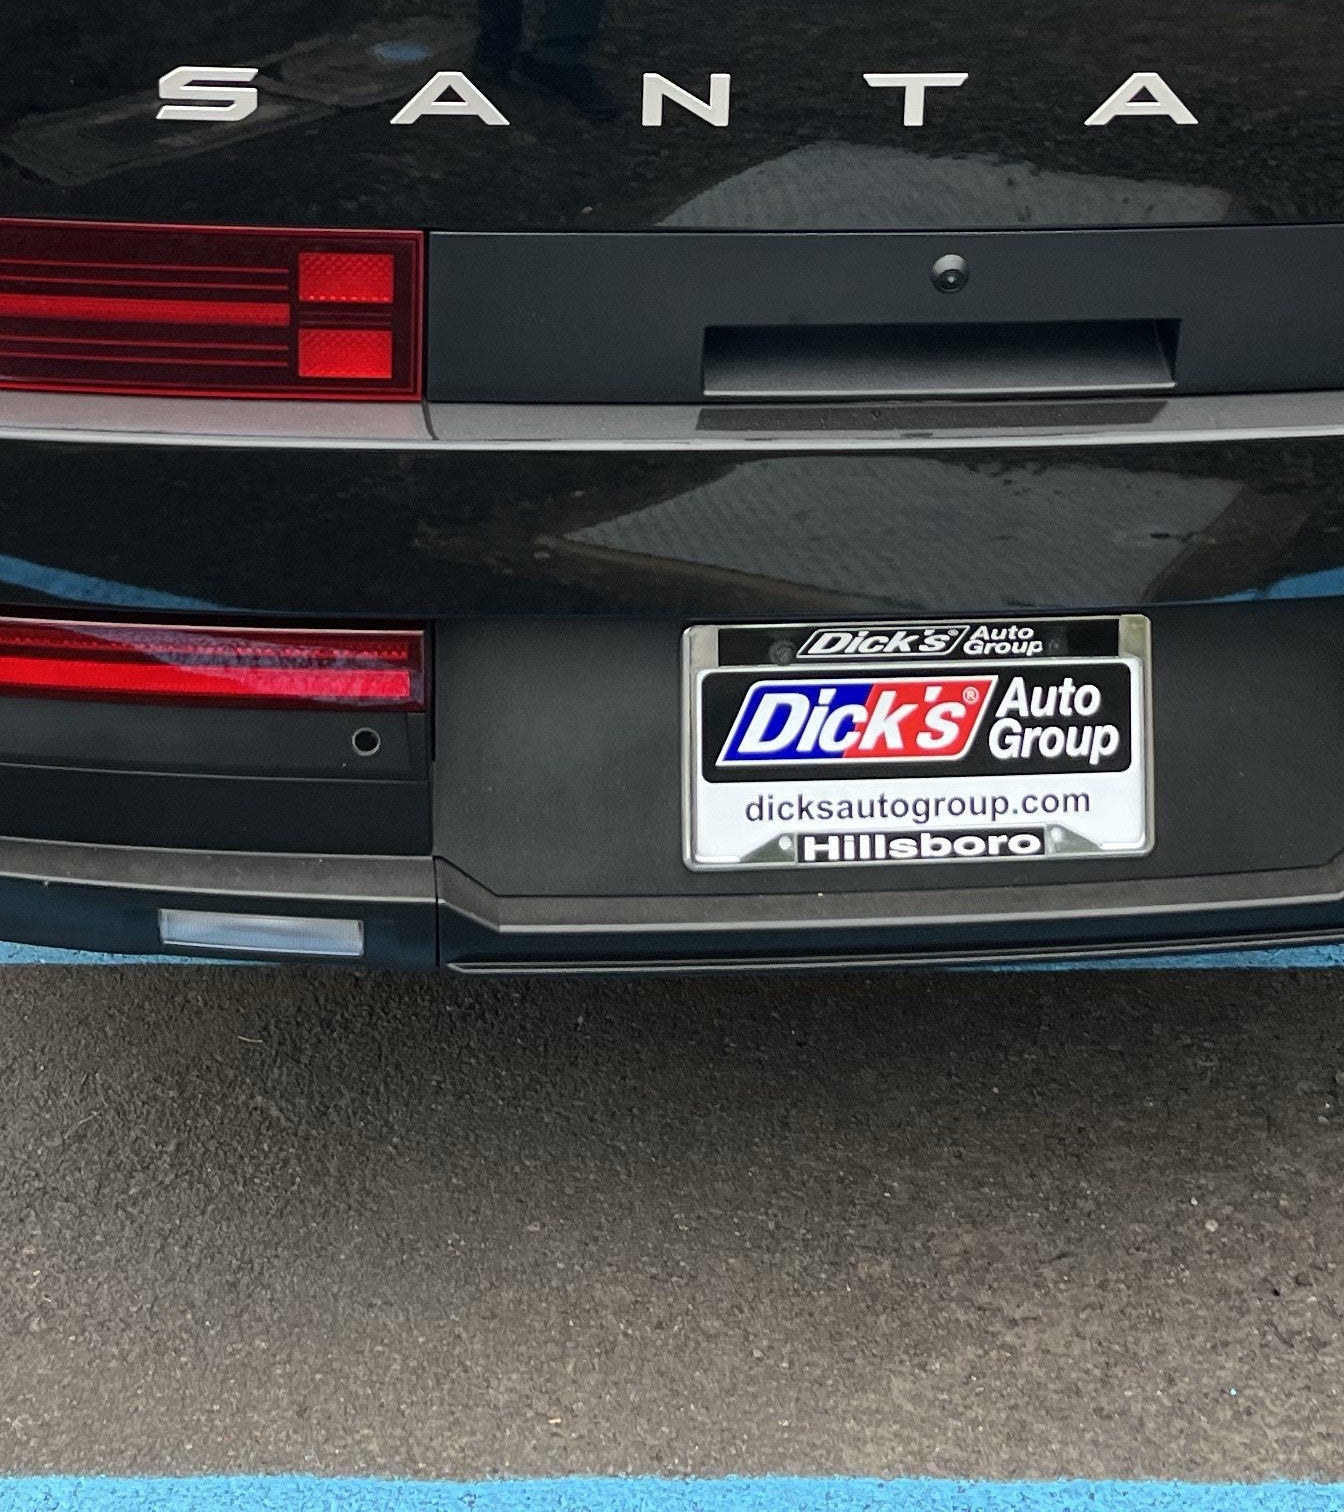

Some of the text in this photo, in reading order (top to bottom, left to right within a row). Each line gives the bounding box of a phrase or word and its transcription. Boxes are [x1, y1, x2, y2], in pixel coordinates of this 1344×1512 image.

[156, 65, 1199, 127] SANTA
[807, 629, 952, 654] Dick's
[963, 638, 1044, 657] Group
[969, 625, 1035, 641] Auto
[994, 676, 1102, 718] Auto
[737, 686, 967, 754] Dick's
[988, 717, 1120, 766] Group
[744, 791, 1091, 825] dicksautogroup.com
[803, 832, 1042, 863] Hillsboro
